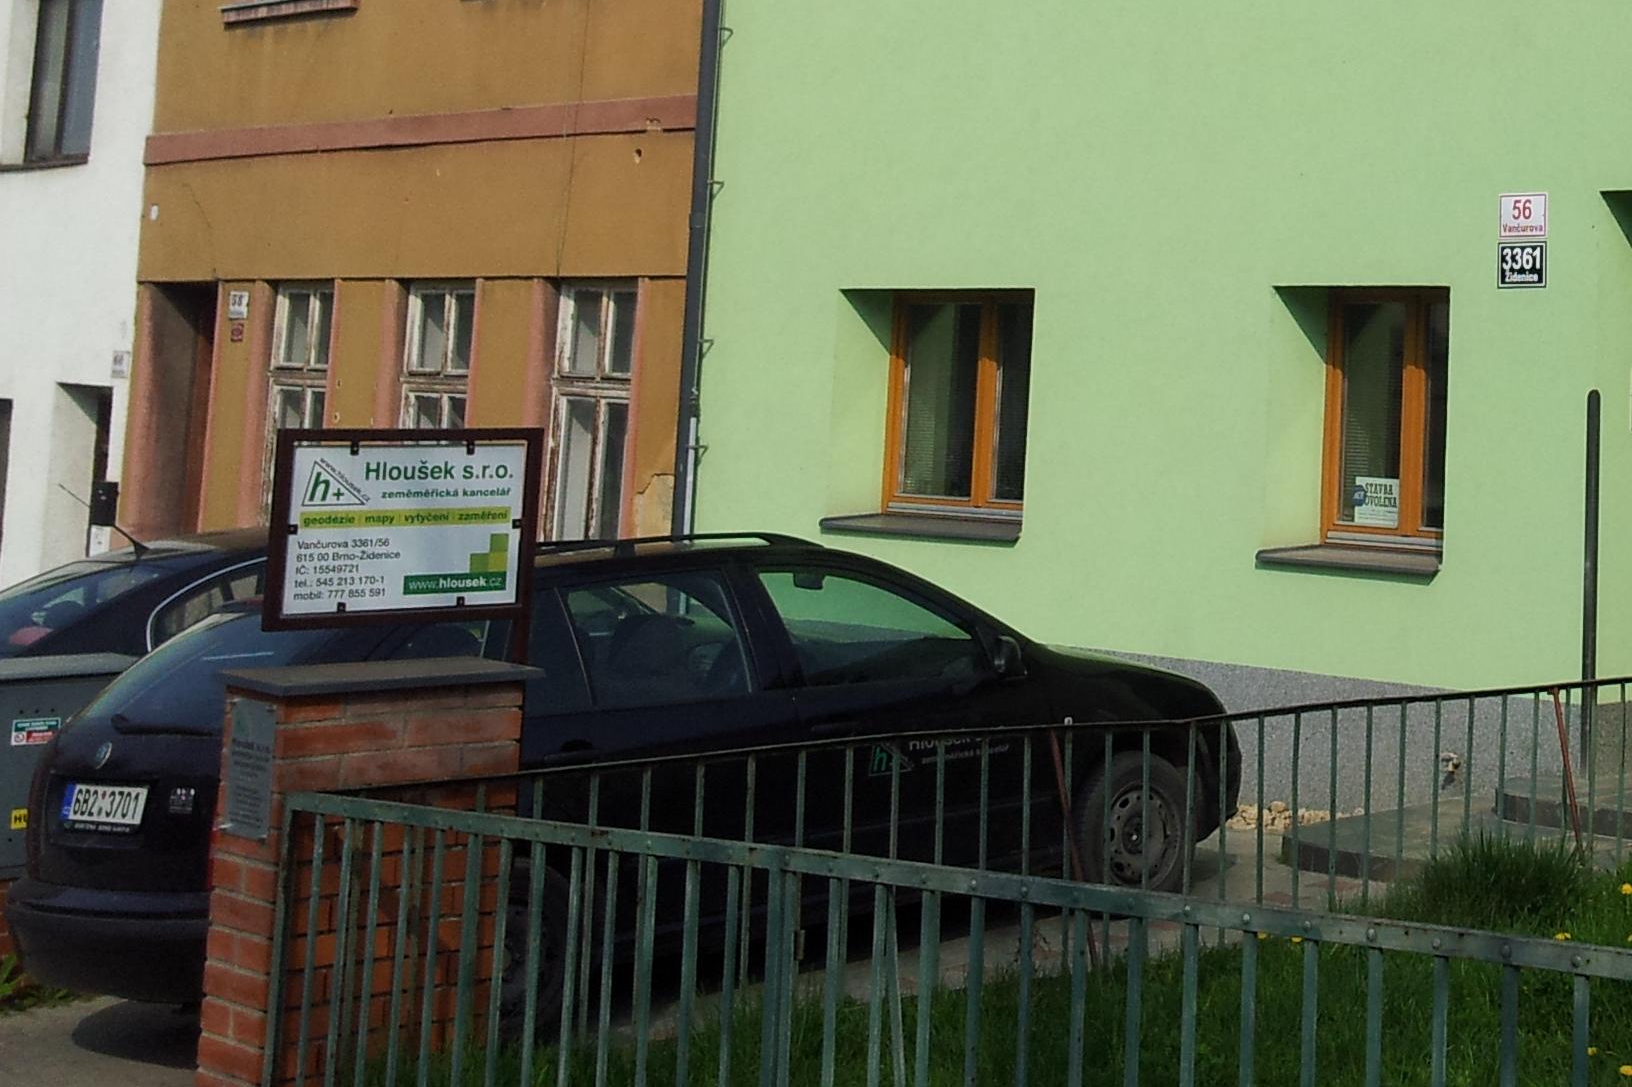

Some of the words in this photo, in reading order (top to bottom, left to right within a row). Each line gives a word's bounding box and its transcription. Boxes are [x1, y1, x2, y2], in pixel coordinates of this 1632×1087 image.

[1512, 199, 1532, 220] 56
[1502, 246, 1541, 270] 3361
[365, 460, 455, 481] Hloušek
[462, 464, 513, 480] s.r.o.
[381, 488, 459, 499] zeměměřická
[462, 487, 512, 497] kancelář
[1362, 495, 1397, 508] OVOLENA
[303, 515, 356, 527] geodézie
[365, 515, 395, 525] mapy
[404, 512, 449, 524] vytyčení
[458, 509, 508, 521] zaměření
[298, 539, 349, 550] Vančurova
[351, 538, 390, 548] 3361/56
[296, 553, 315, 563] 615
[317, 552, 330, 562] 00
[332, 550, 401, 561] Brno-Židenice
[313, 564, 360, 575] 15549721
[316, 577, 334, 587] 545
[336, 577, 355, 586] 213
[358, 575, 385, 585] 170-1
[408, 577, 503, 591] www.hlousek.cz
[327, 589, 346, 599] 777
[369, 588, 386, 598] 591
[73, 788, 99, 816] 6B2
[105, 791, 140, 819] 3701
